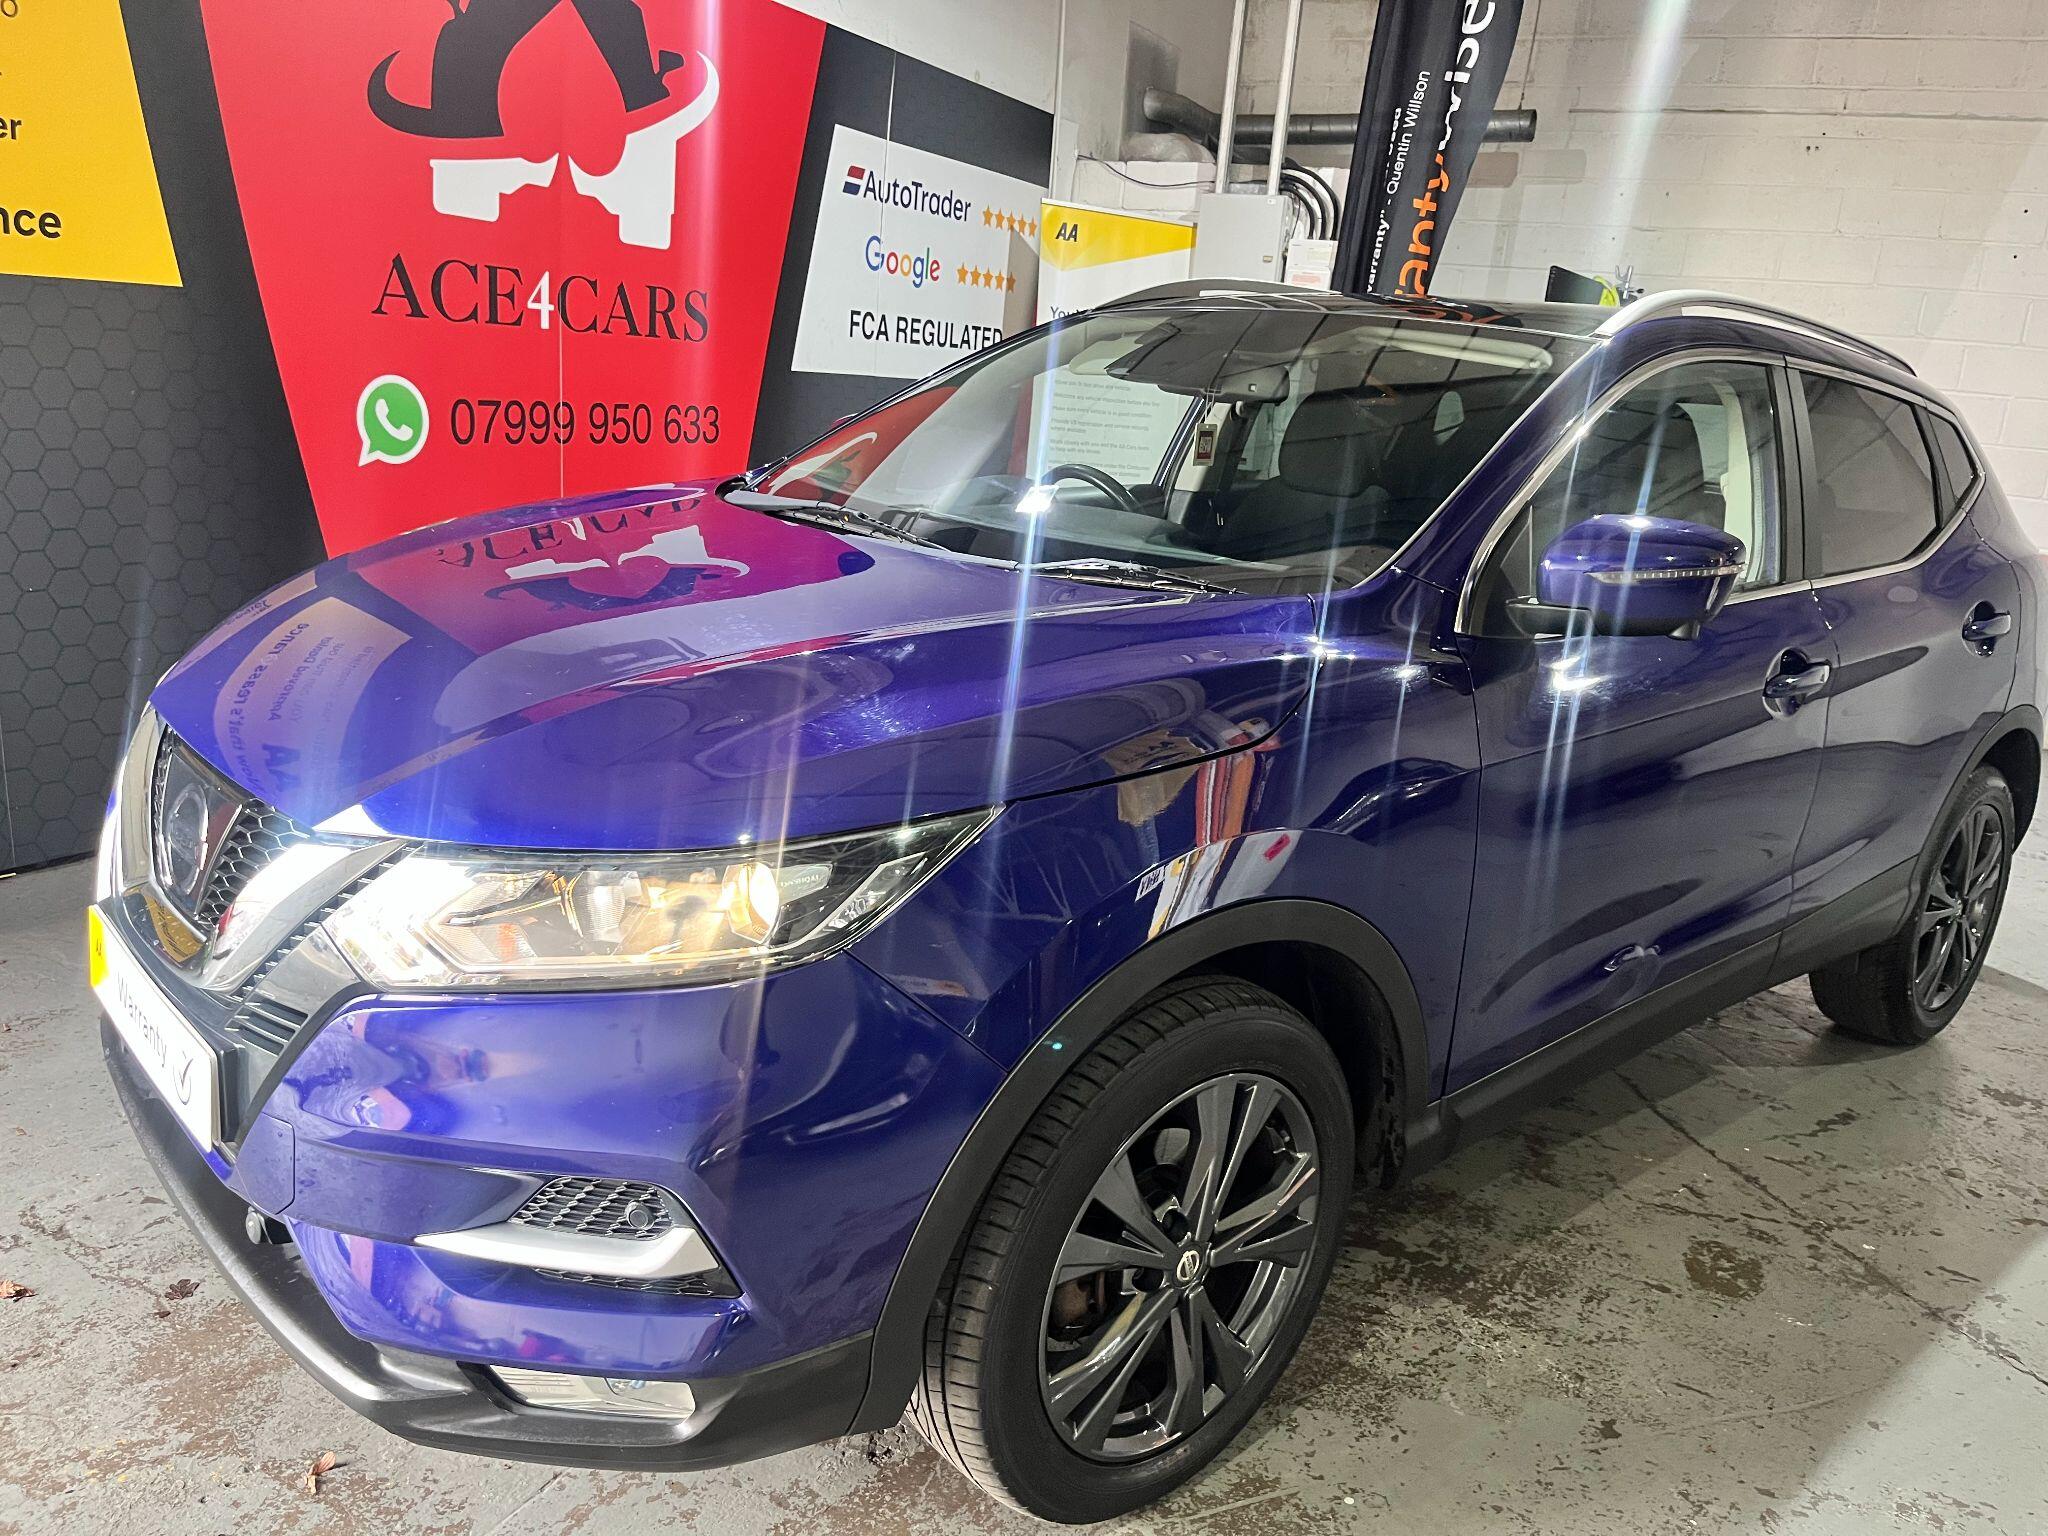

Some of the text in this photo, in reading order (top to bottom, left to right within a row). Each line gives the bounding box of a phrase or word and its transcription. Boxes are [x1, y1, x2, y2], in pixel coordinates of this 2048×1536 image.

[1387, 132, 1413, 195] Quentin
[1402, 70, 1431, 128] Willson
[863, 170, 971, 222] AutoTrader
[1055, 222, 1079, 243] AA
[865, 235, 941, 289] Google
[371, 252, 710, 343] ACE4CARS
[849, 310, 889, 342] FCA
[450, 398, 721, 446] 07999 950 633
[117, 970, 167, 1068] Warranty
